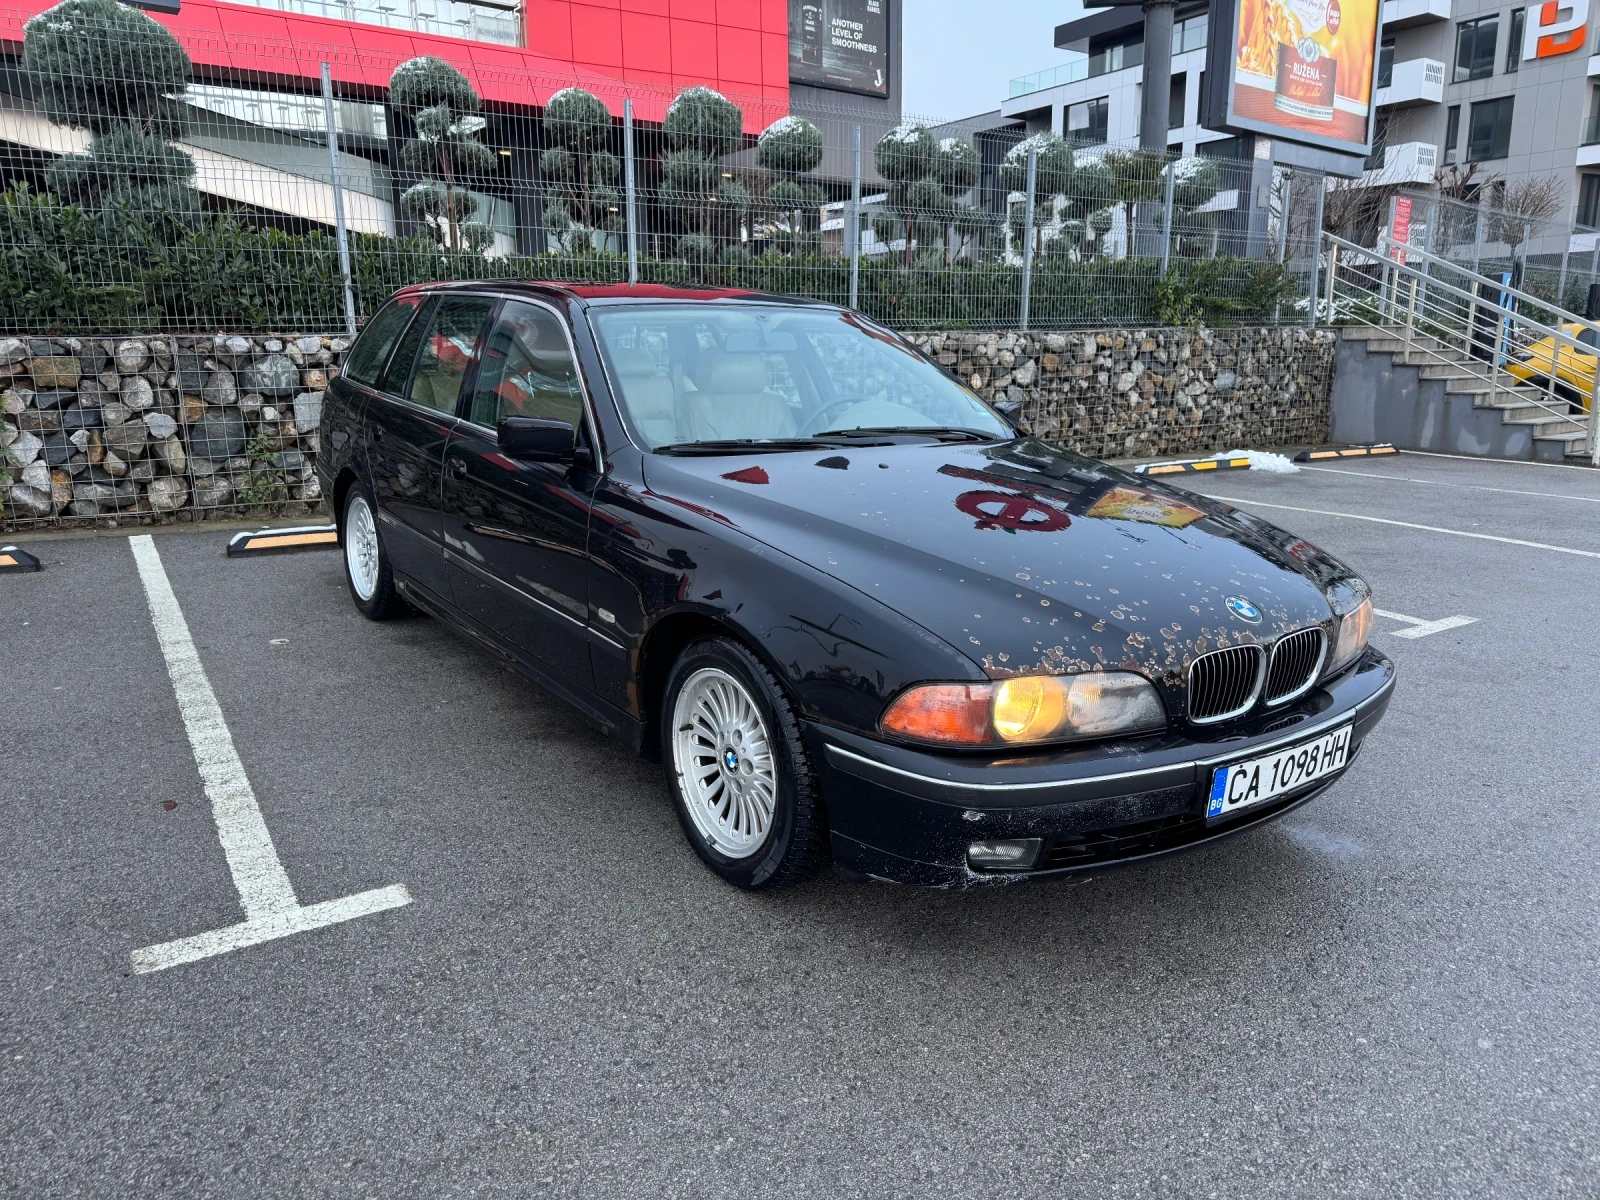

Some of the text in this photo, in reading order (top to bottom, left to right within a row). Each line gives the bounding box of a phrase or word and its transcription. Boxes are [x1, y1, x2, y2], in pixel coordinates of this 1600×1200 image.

[831, 18, 863, 31] ANOTHER
[831, 27, 863, 40] LEVEL OF
[831, 37, 877, 53] SMOOTHNESS
[1293, 62, 1320, 80] RUŽENA
[1228, 731, 1348, 804] CA 1098 HH
[1210, 798, 1223, 811] BG
